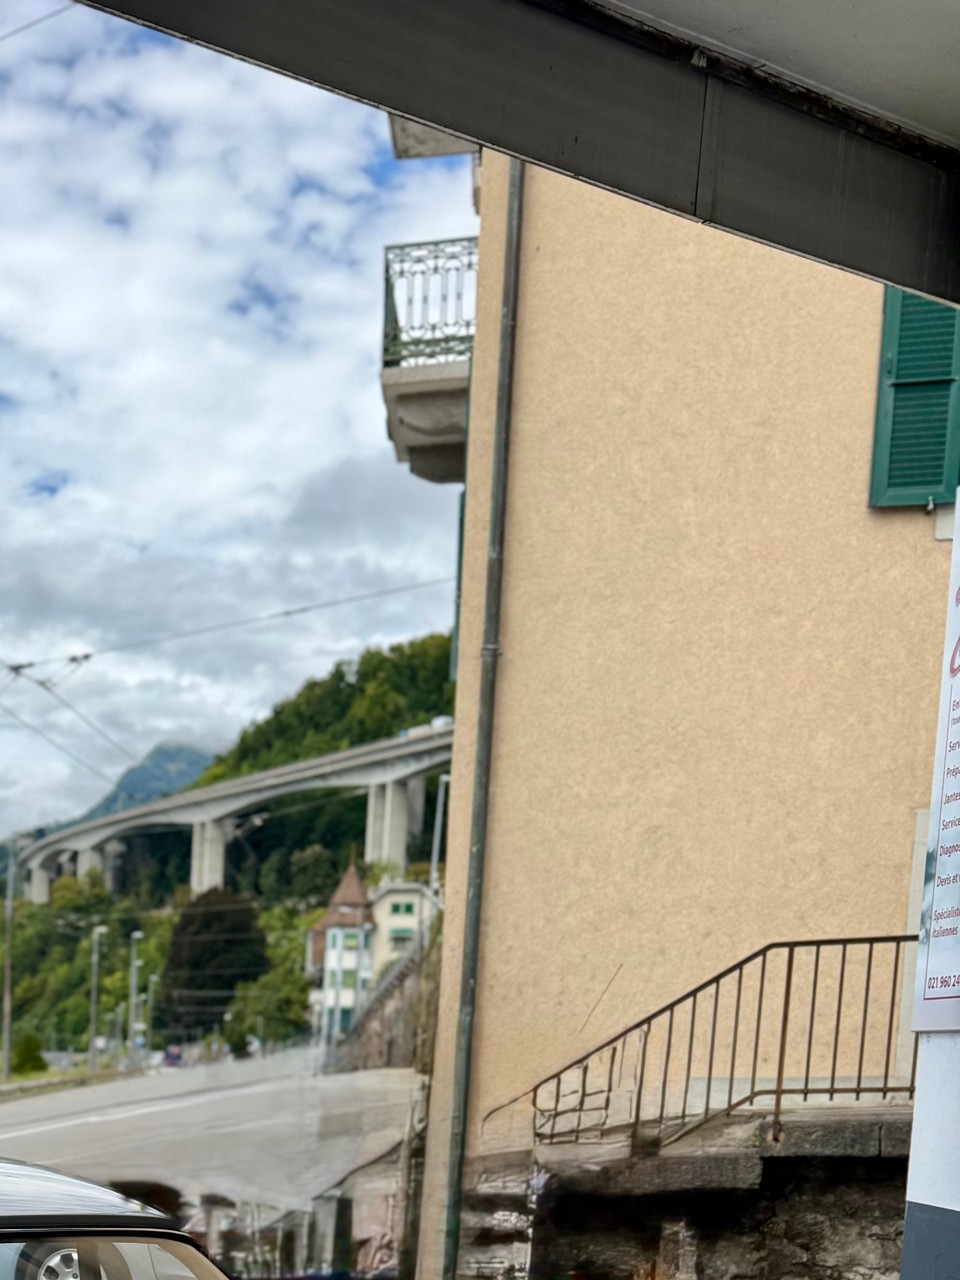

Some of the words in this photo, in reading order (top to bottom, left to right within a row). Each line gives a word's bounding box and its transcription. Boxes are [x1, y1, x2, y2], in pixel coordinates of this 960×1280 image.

[936, 873, 951, 887] Devis
[932, 926, 958, 938] italiennes
[927, 976, 938, 989] 021
[940, 975, 951, 988] 960
